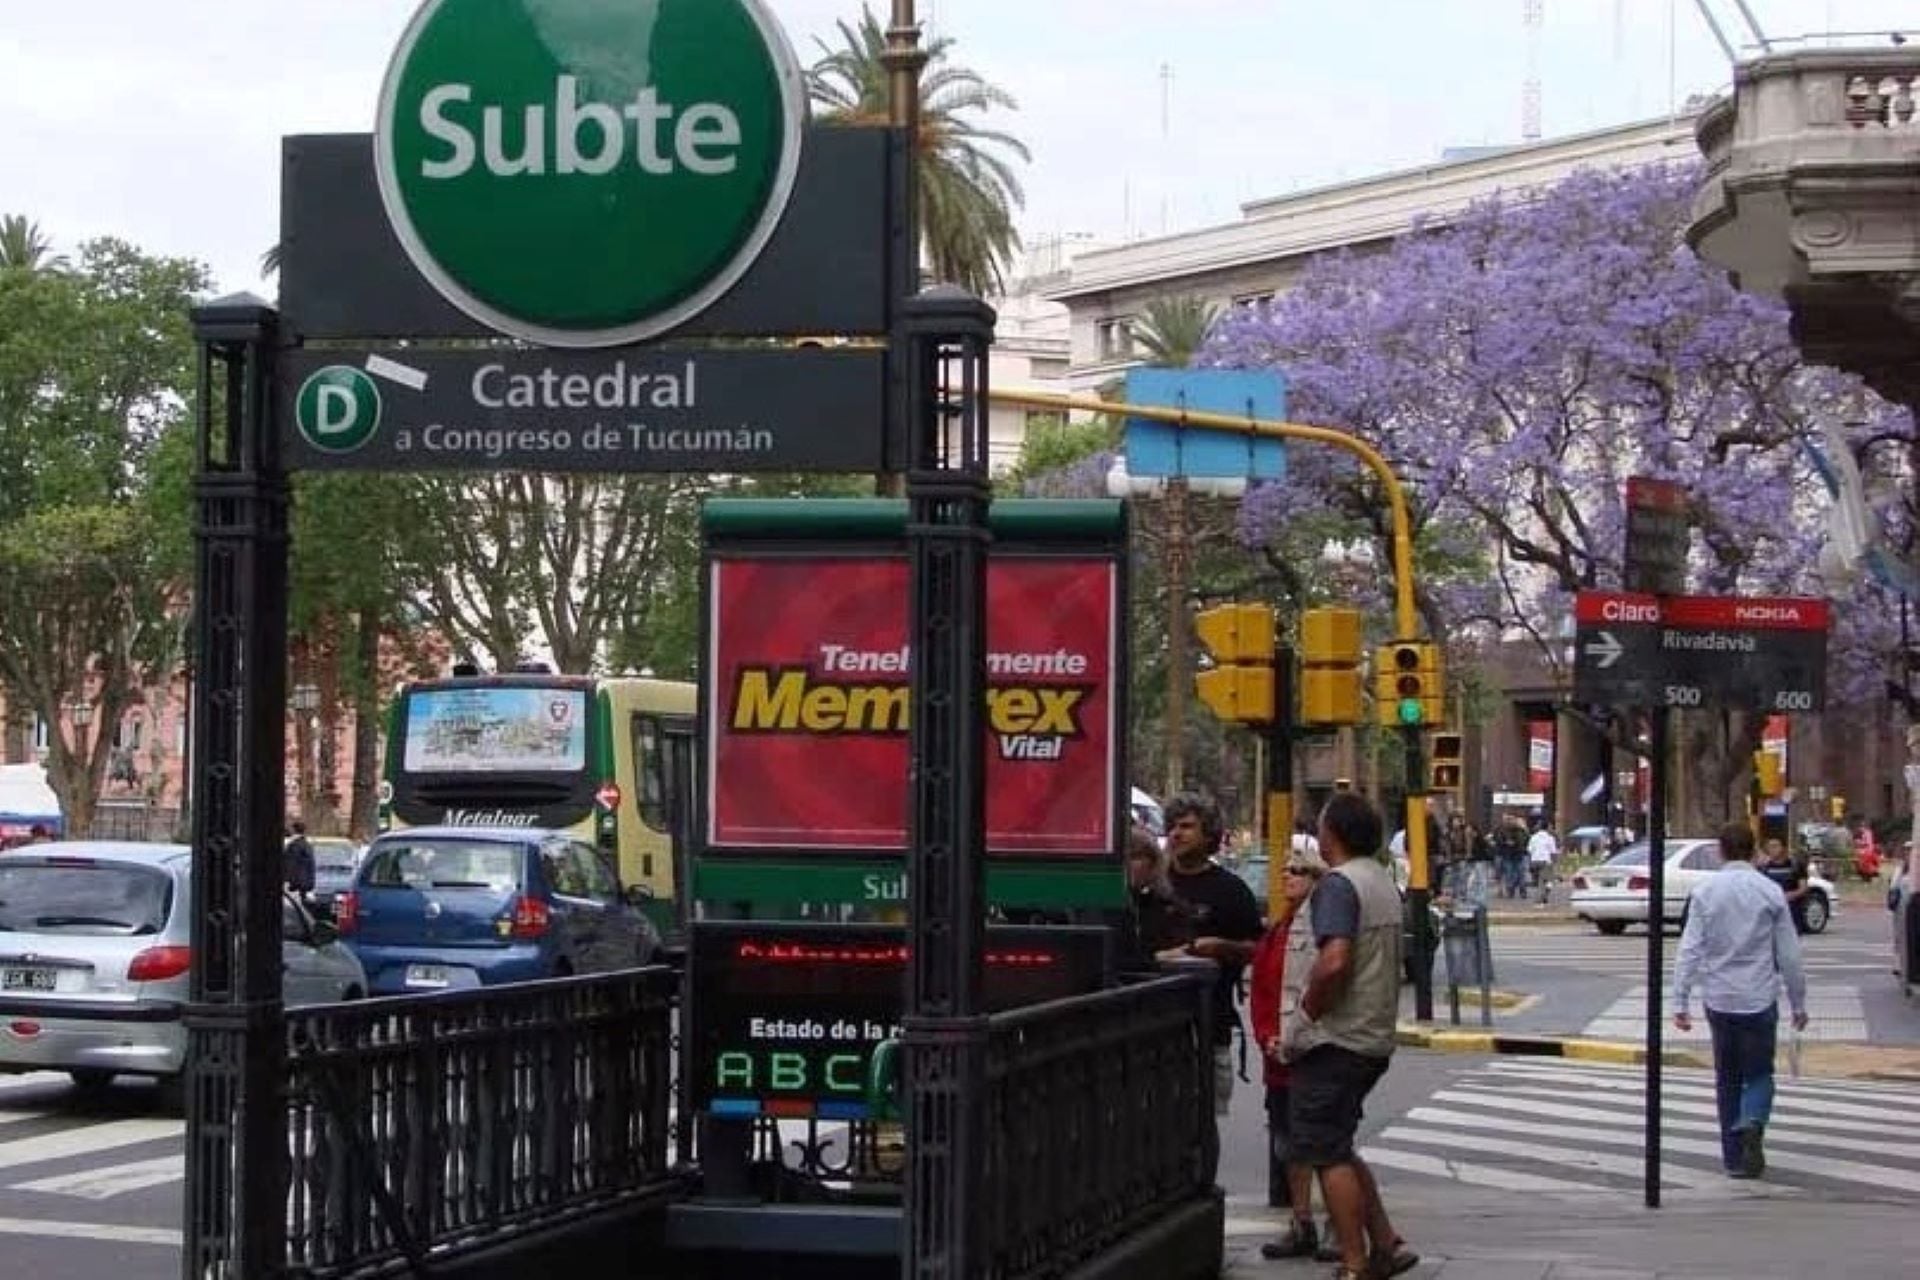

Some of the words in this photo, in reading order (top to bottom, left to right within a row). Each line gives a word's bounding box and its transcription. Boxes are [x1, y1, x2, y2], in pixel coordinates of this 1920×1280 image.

[419, 75, 742, 179] Subte
[471, 361, 696, 409] Catedral
[316, 383, 356, 433] D
[395, 430, 412, 450] a
[422, 424, 571, 458] Congreso
[582, 422, 622, 450] de
[627, 422, 774, 451] Tucumán
[1602, 600, 1660, 623] Claro
[1735, 607, 1800, 620] NOKIA
[1663, 630, 1756, 652] Rivadavia
[1665, 685, 1701, 705] 500
[1775, 691, 1812, 710] 600
[1000, 735, 1062, 760] Vital
[750, 1017, 824, 1038] Estado
[830, 1019, 857, 1039] de
[864, 1020, 883, 1039] la
[717, 1053, 753, 1087] A
[771, 1053, 807, 1089] B
[825, 1055, 862, 1089] C
